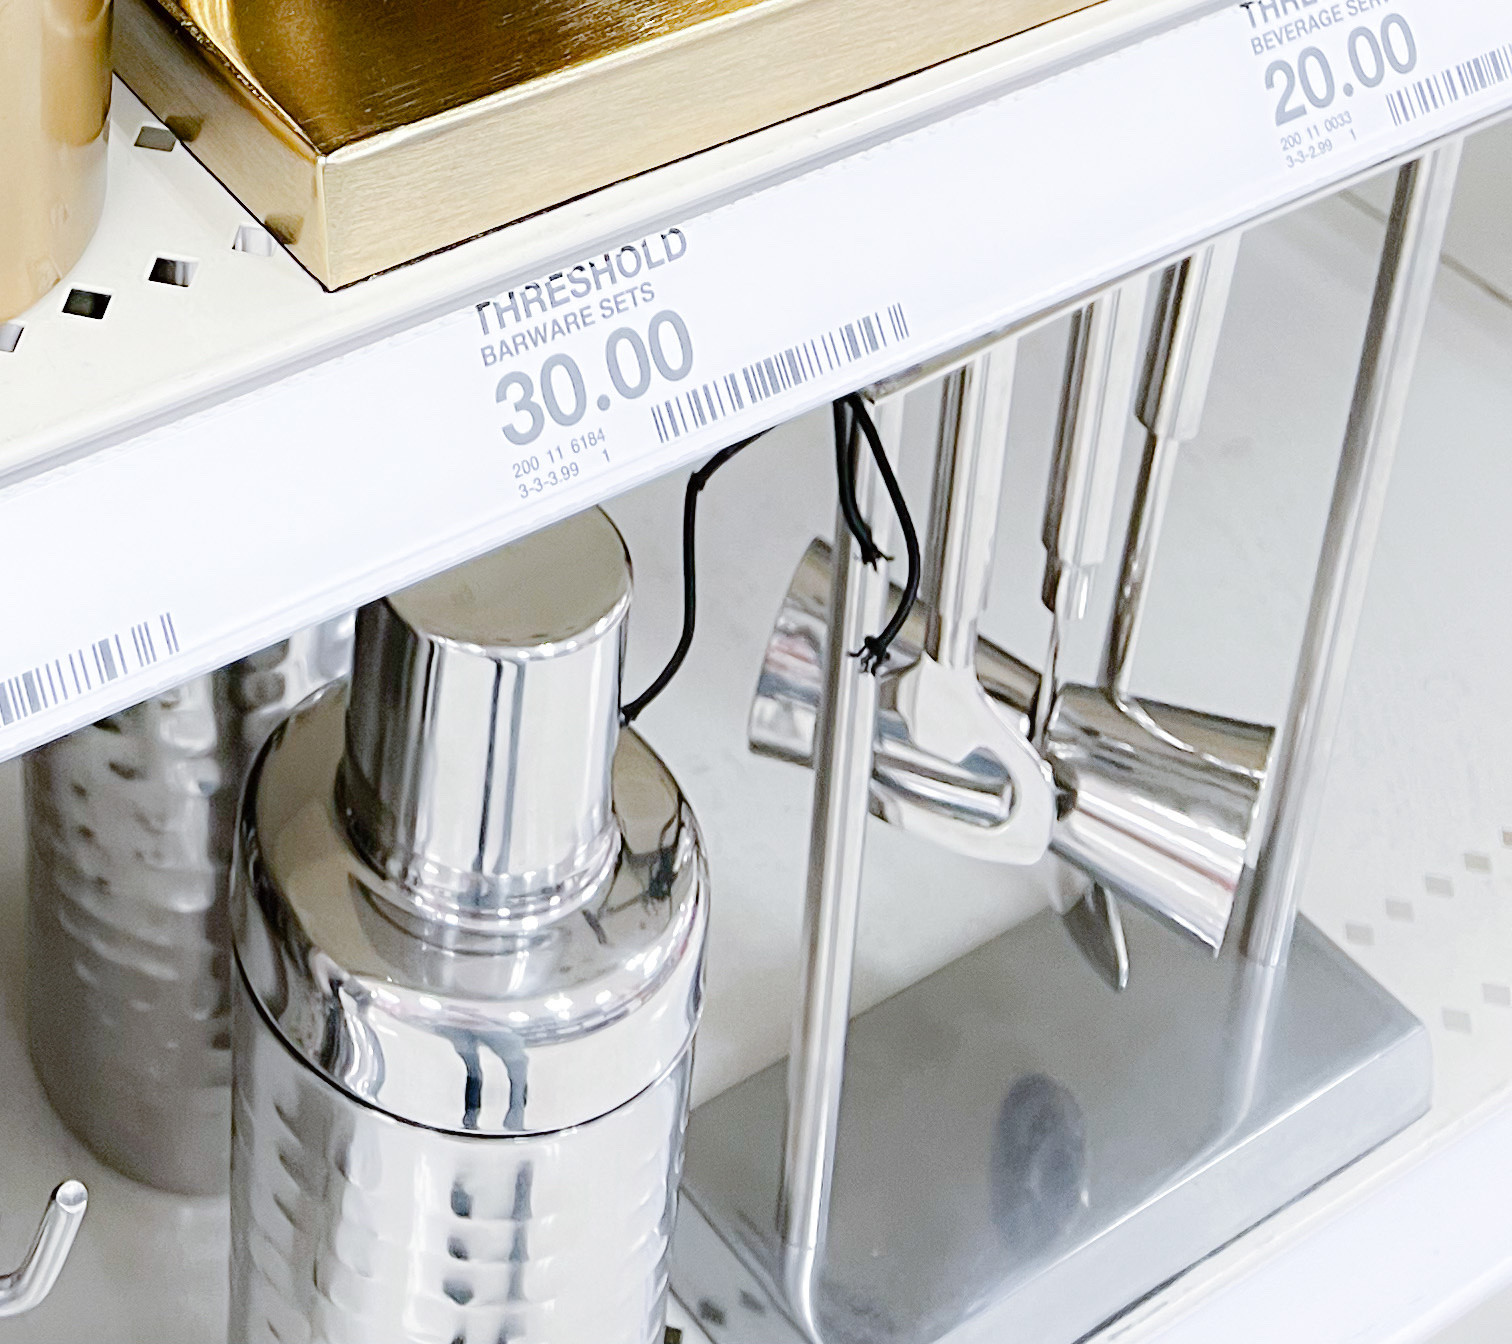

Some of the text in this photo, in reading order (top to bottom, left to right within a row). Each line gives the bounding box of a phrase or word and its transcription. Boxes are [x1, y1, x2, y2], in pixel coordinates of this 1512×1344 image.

[1250, 4, 1344, 56] BEVERAGE
[1265, 13, 1418, 127] 20.00
[474, 227, 688, 336] THRESHOLD
[480, 282, 656, 367] BARWARE SETS
[494, 309, 694, 446] 30.00
[511, 427, 606, 479] 200 11 6184
